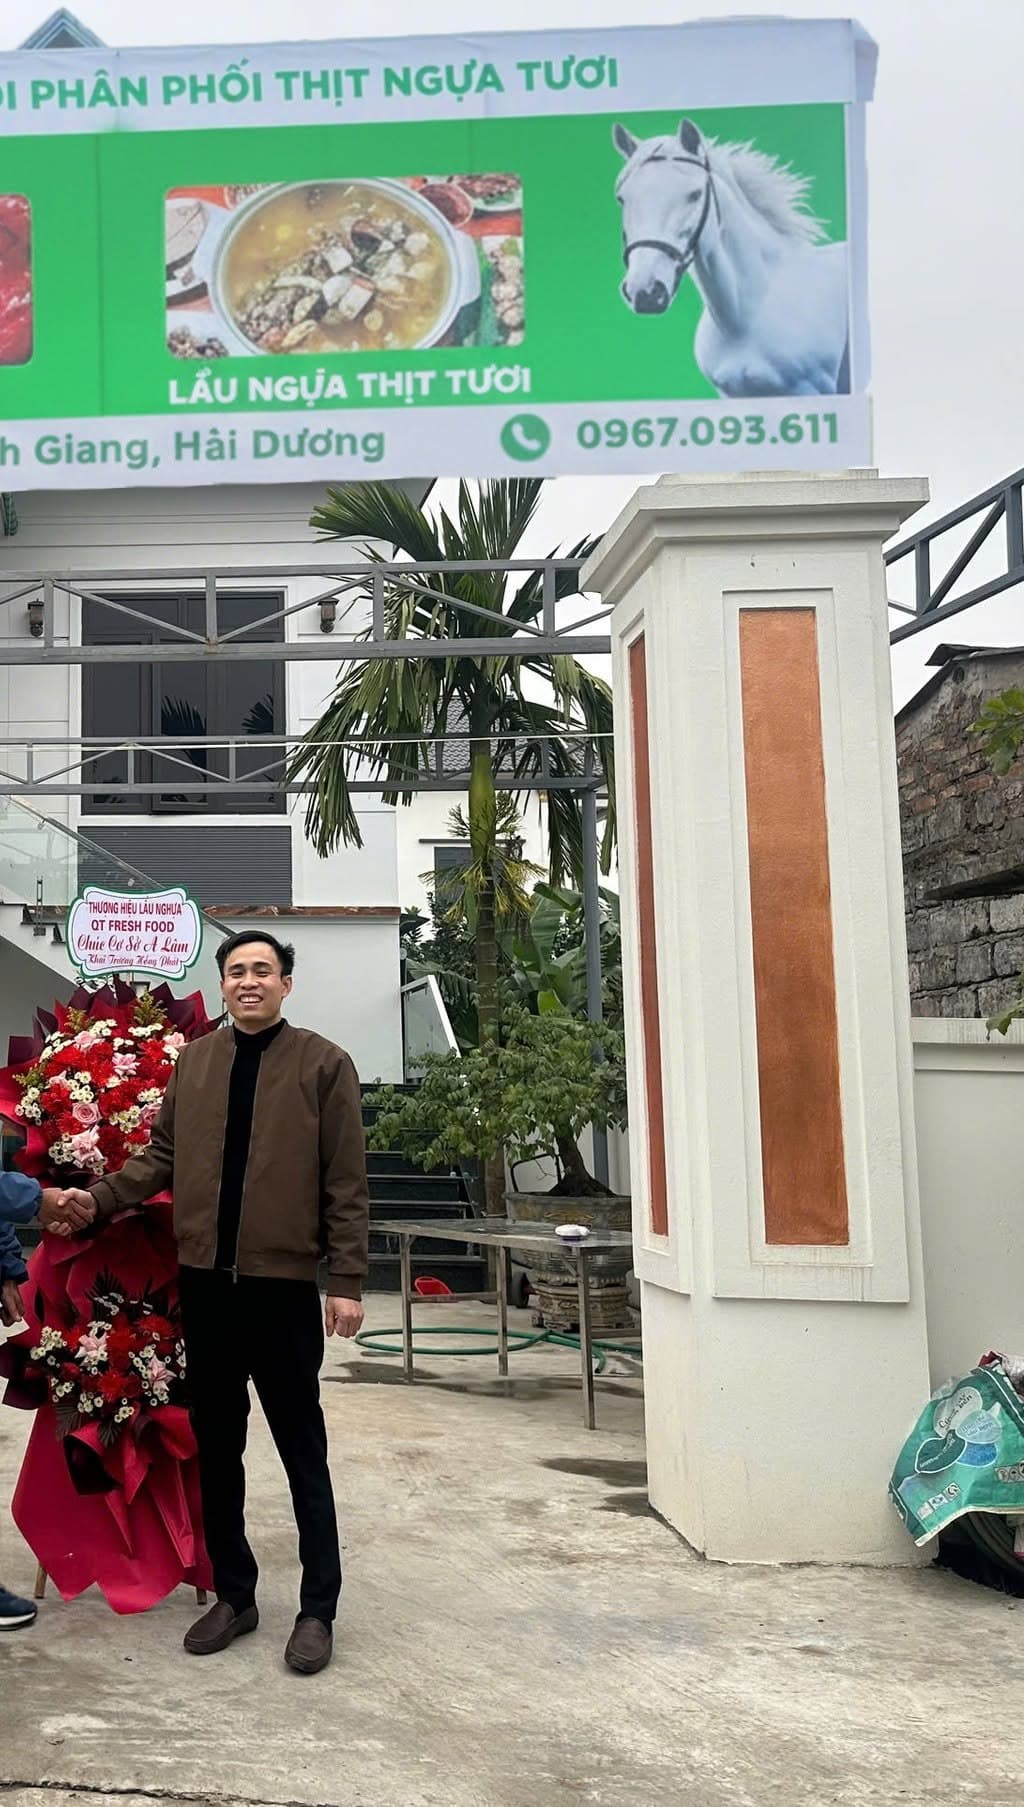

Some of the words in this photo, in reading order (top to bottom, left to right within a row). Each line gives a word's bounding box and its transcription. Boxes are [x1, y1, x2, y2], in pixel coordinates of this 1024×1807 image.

[30, 69, 148, 109] PHÂN
[161, 58, 263, 105] PHỐI
[274, 68, 370, 107] THỊT
[383, 58, 505, 103] NGỰA
[516, 54, 619, 92] TƯƠI
[248, 368, 348, 408] NGỰA
[357, 370, 436, 405] THỊT
[445, 363, 531, 395] TƯƠI
[34, 433, 160, 470] Giang,
[252, 427, 385, 463] Dương
[577, 412, 838, 449] 0967.093.611
[91, 919, 106, 932] QT
[108, 919, 143, 933] FRESH
[145, 920, 175, 933] FOOD
